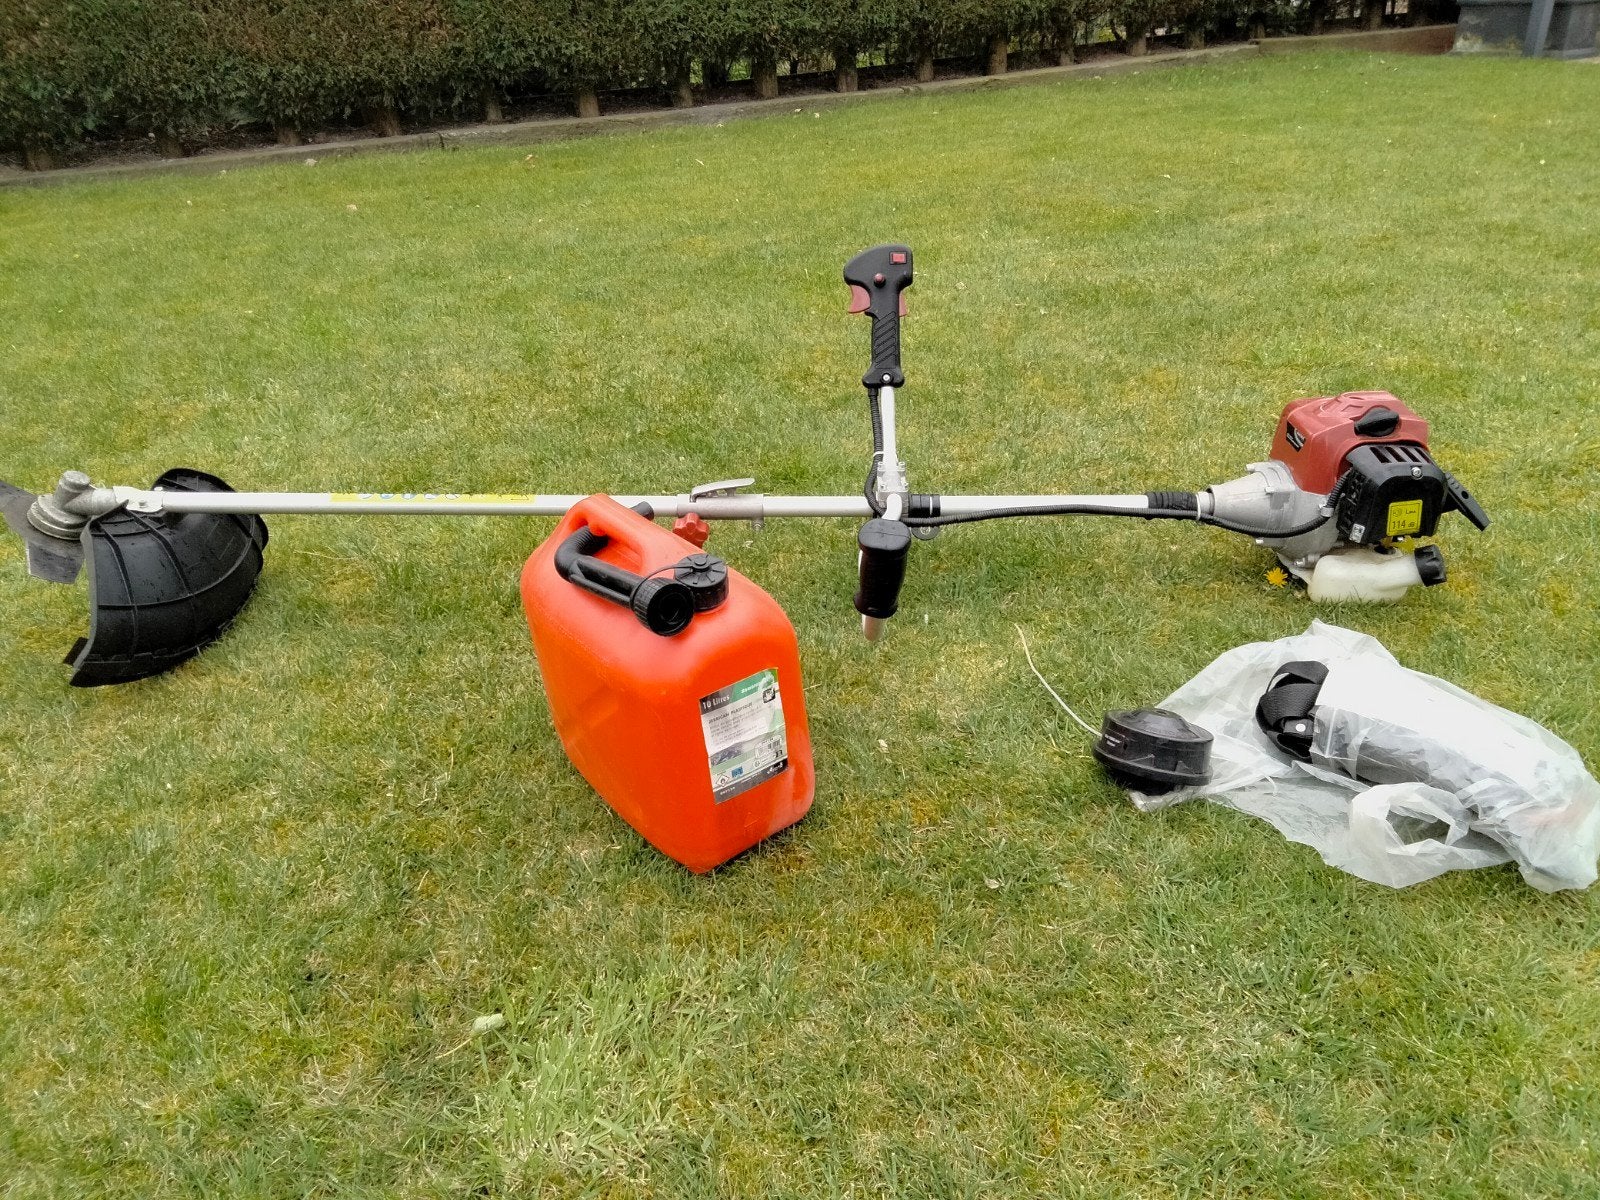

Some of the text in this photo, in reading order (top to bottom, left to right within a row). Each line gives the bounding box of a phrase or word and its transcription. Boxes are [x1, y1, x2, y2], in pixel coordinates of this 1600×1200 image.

[1392, 520, 1406, 530] 114
[702, 694, 730, 710] 10 Litres
